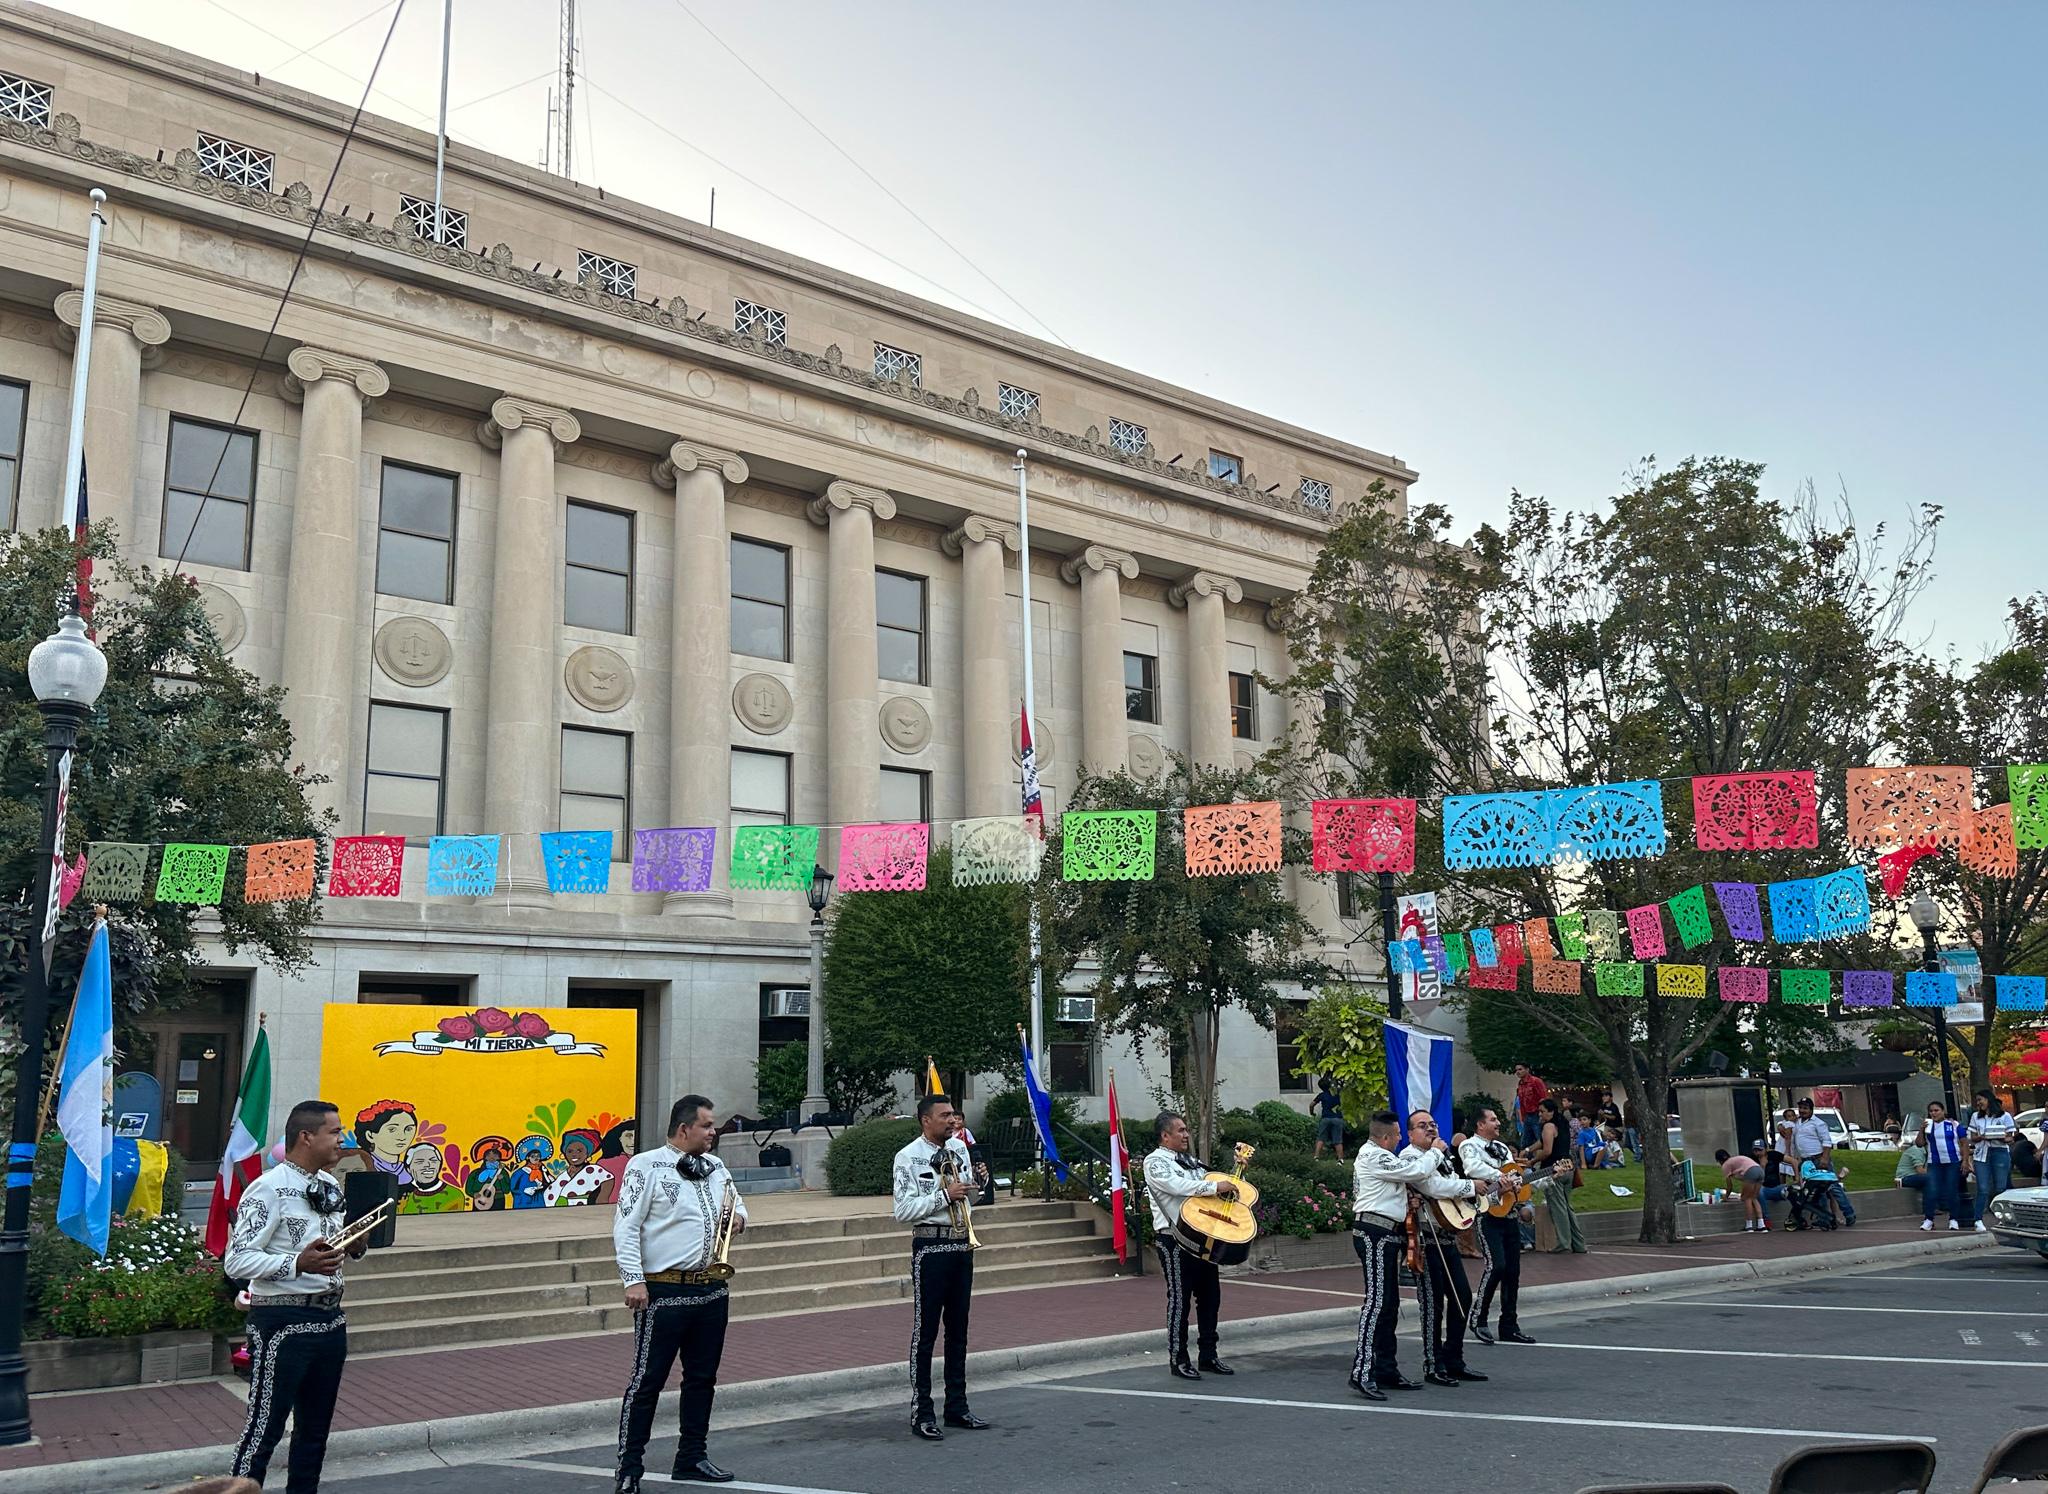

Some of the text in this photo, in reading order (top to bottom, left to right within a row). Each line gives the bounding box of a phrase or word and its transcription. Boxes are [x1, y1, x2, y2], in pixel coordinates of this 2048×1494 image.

[596, 344, 945, 466] COURT
[1091, 481, 1316, 563] HOUSE
[1417, 895, 1430, 908] The
[1419, 907, 1439, 998] SQRE
[1946, 964, 1978, 974] SQUARE
[465, 1038, 535, 1050] MI TIERRA
